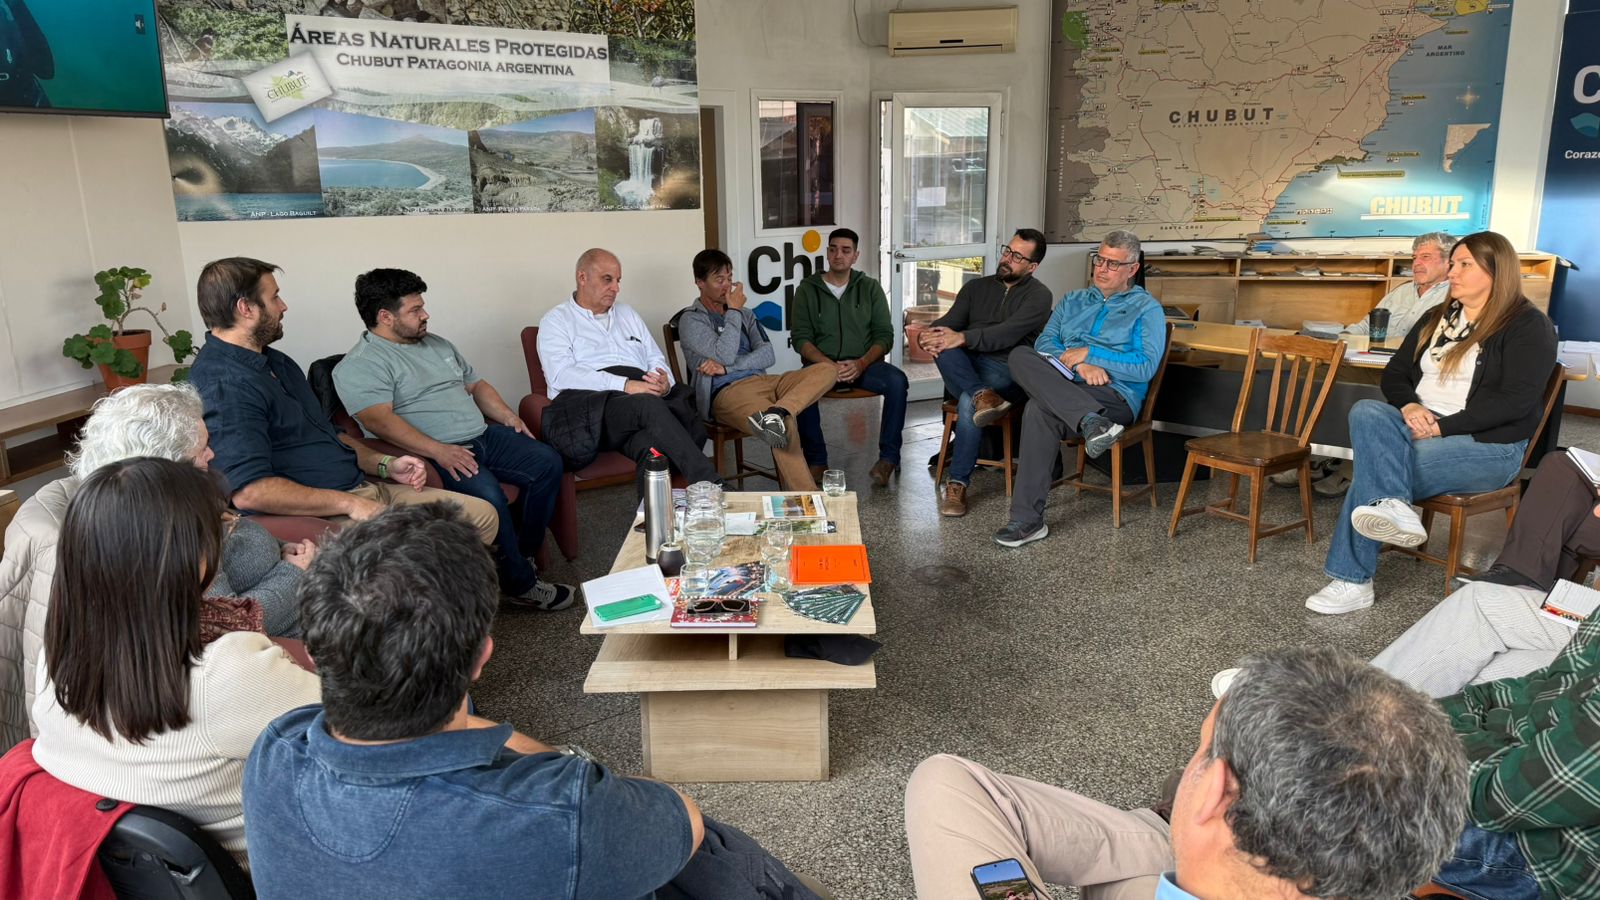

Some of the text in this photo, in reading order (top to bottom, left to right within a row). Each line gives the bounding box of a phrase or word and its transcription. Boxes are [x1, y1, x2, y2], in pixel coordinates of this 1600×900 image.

[290, 23, 608, 60] ÁREAS NATURALES PROTEGIDAS
[336, 53, 574, 76] CHUBUT PATAGONIA ARGENTINA
[267, 75, 308, 100] CHUBUT
[1169, 107, 1274, 123] CHUBUT
[1371, 196, 1463, 215] CHUBUT
